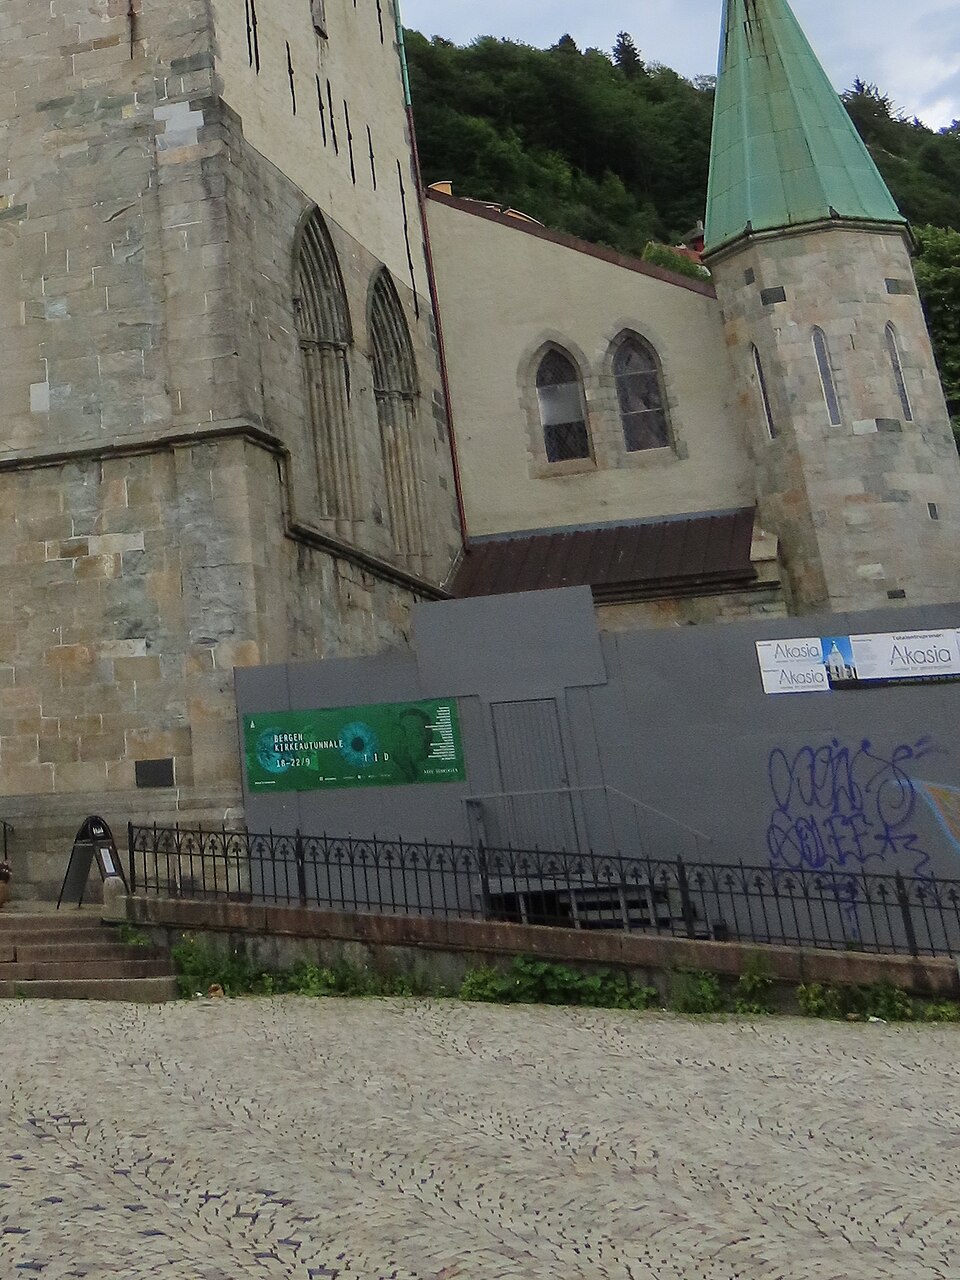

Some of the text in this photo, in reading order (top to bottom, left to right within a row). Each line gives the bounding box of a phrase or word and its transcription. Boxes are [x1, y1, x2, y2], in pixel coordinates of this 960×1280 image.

[774, 642, 820, 659] Akasia
[890, 644, 951, 666] Akasia
[779, 668, 825, 685] Akasia
[273, 733, 303, 743] BERGEN
[273, 740, 344, 752] KIRKEAUTUNNALE
